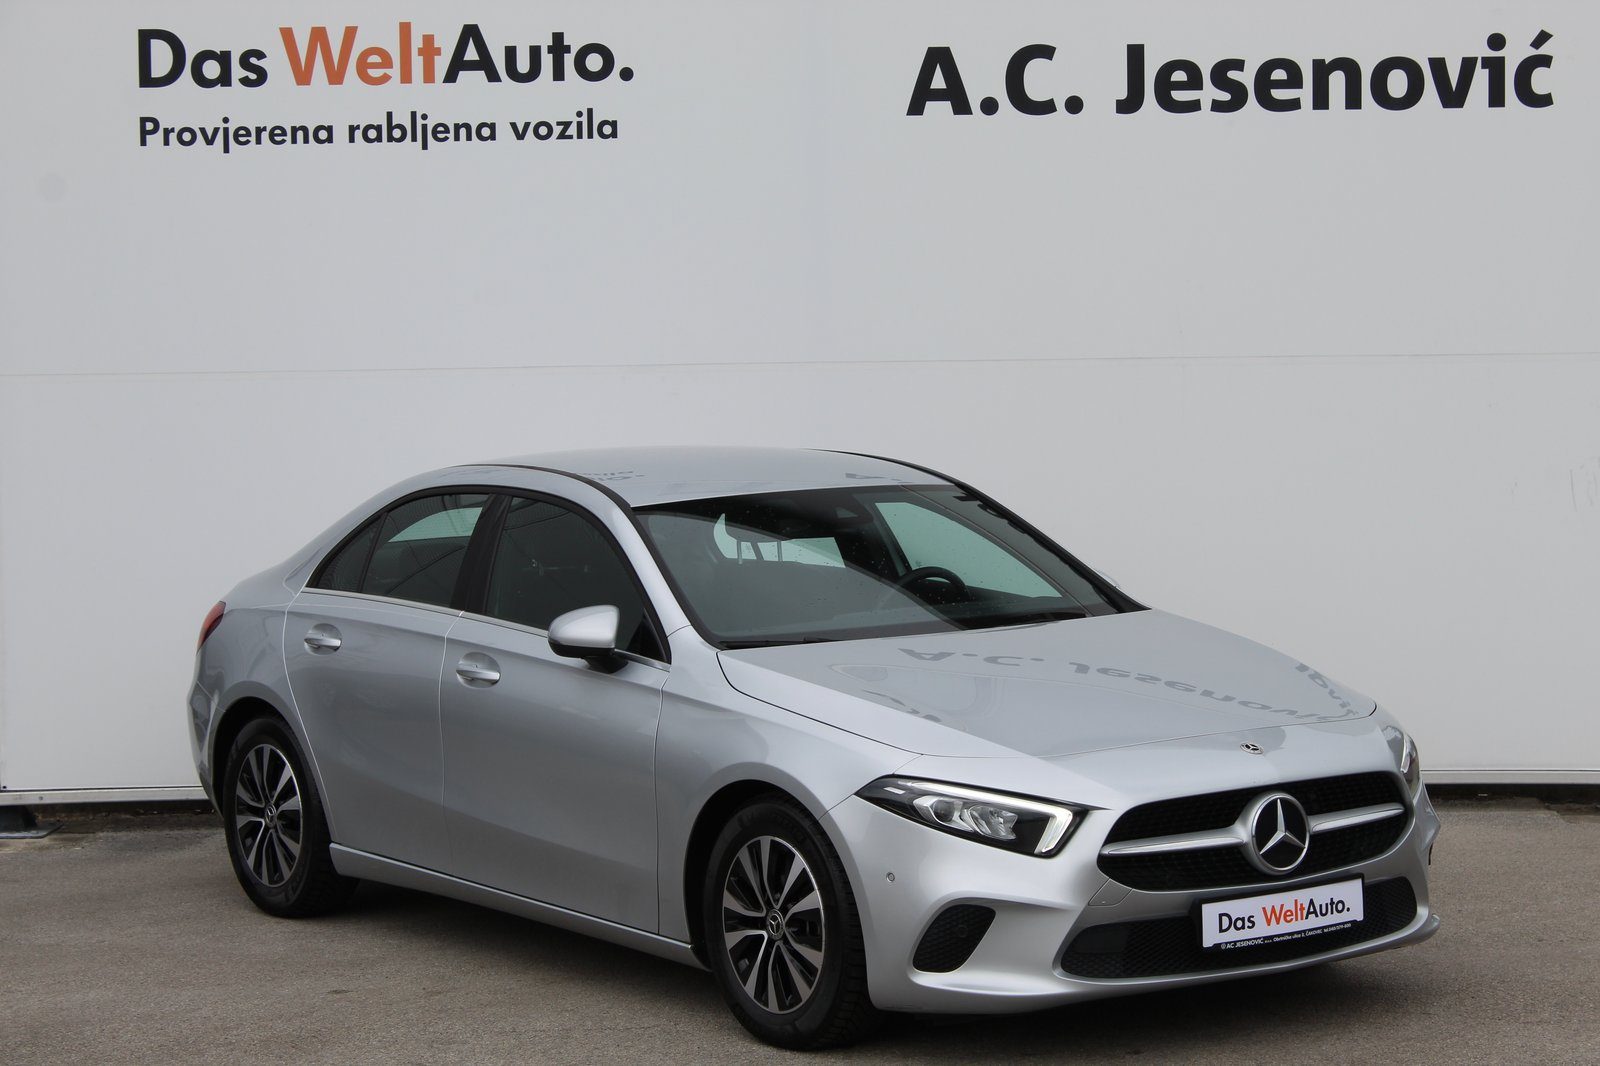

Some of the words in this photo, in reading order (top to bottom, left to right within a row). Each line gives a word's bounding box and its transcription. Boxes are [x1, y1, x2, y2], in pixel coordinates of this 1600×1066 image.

[138, 29, 267, 89] Das
[279, 22, 634, 86] WeltAuto.
[906, 44, 1084, 117] A.C.
[1116, 30, 1554, 115] Jesenović
[139, 117, 334, 153] Provjerena
[348, 111, 497, 151] rabljena
[510, 110, 619, 141] vozila
[1218, 912, 1256, 934] Das
[1262, 898, 1351, 928] WeltAuto.
